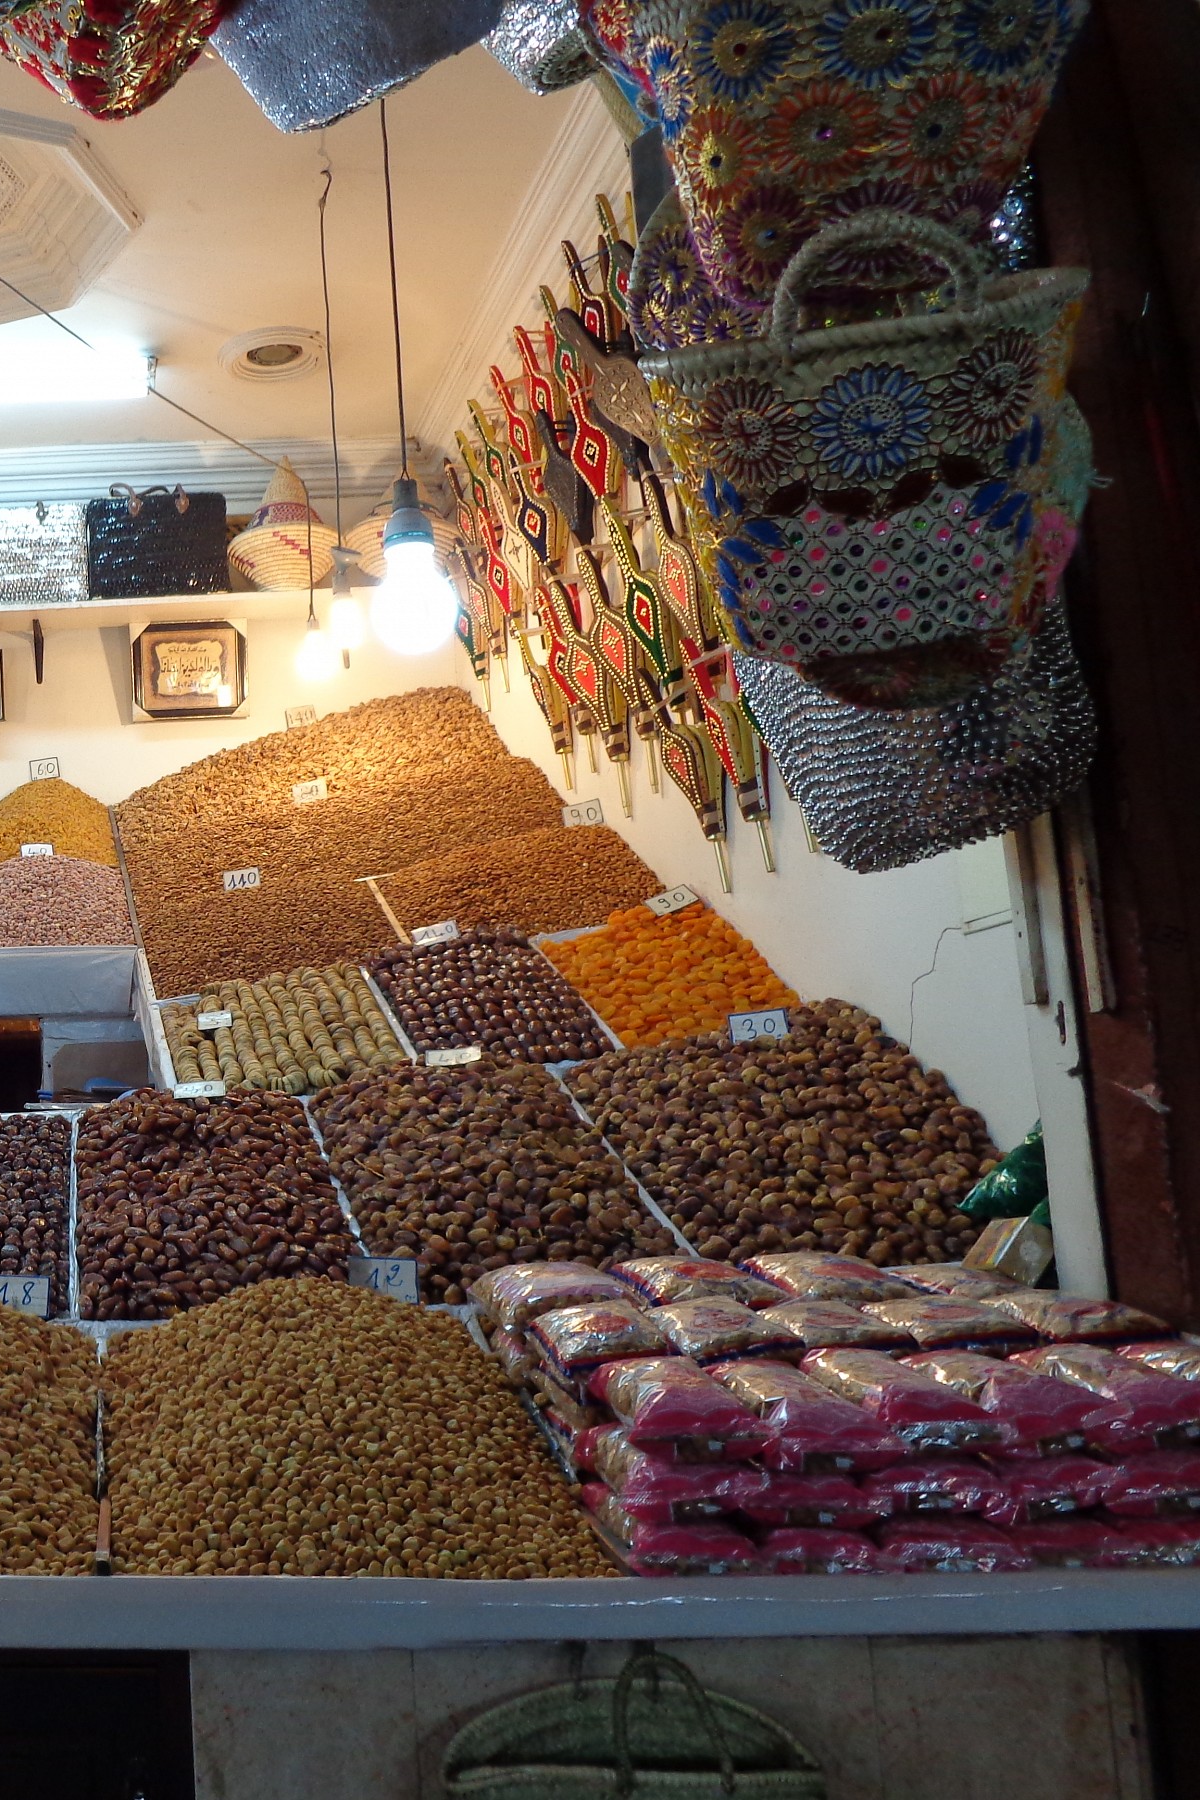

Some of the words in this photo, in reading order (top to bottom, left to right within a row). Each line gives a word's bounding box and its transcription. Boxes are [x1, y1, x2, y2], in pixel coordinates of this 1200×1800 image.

[37, 763, 56, 776] 60
[571, 807, 597, 822] 90
[228, 872, 257, 889] 110
[658, 892, 685, 908] 90
[741, 1018, 775, 1040] 30
[365, 1264, 404, 1289] 12
